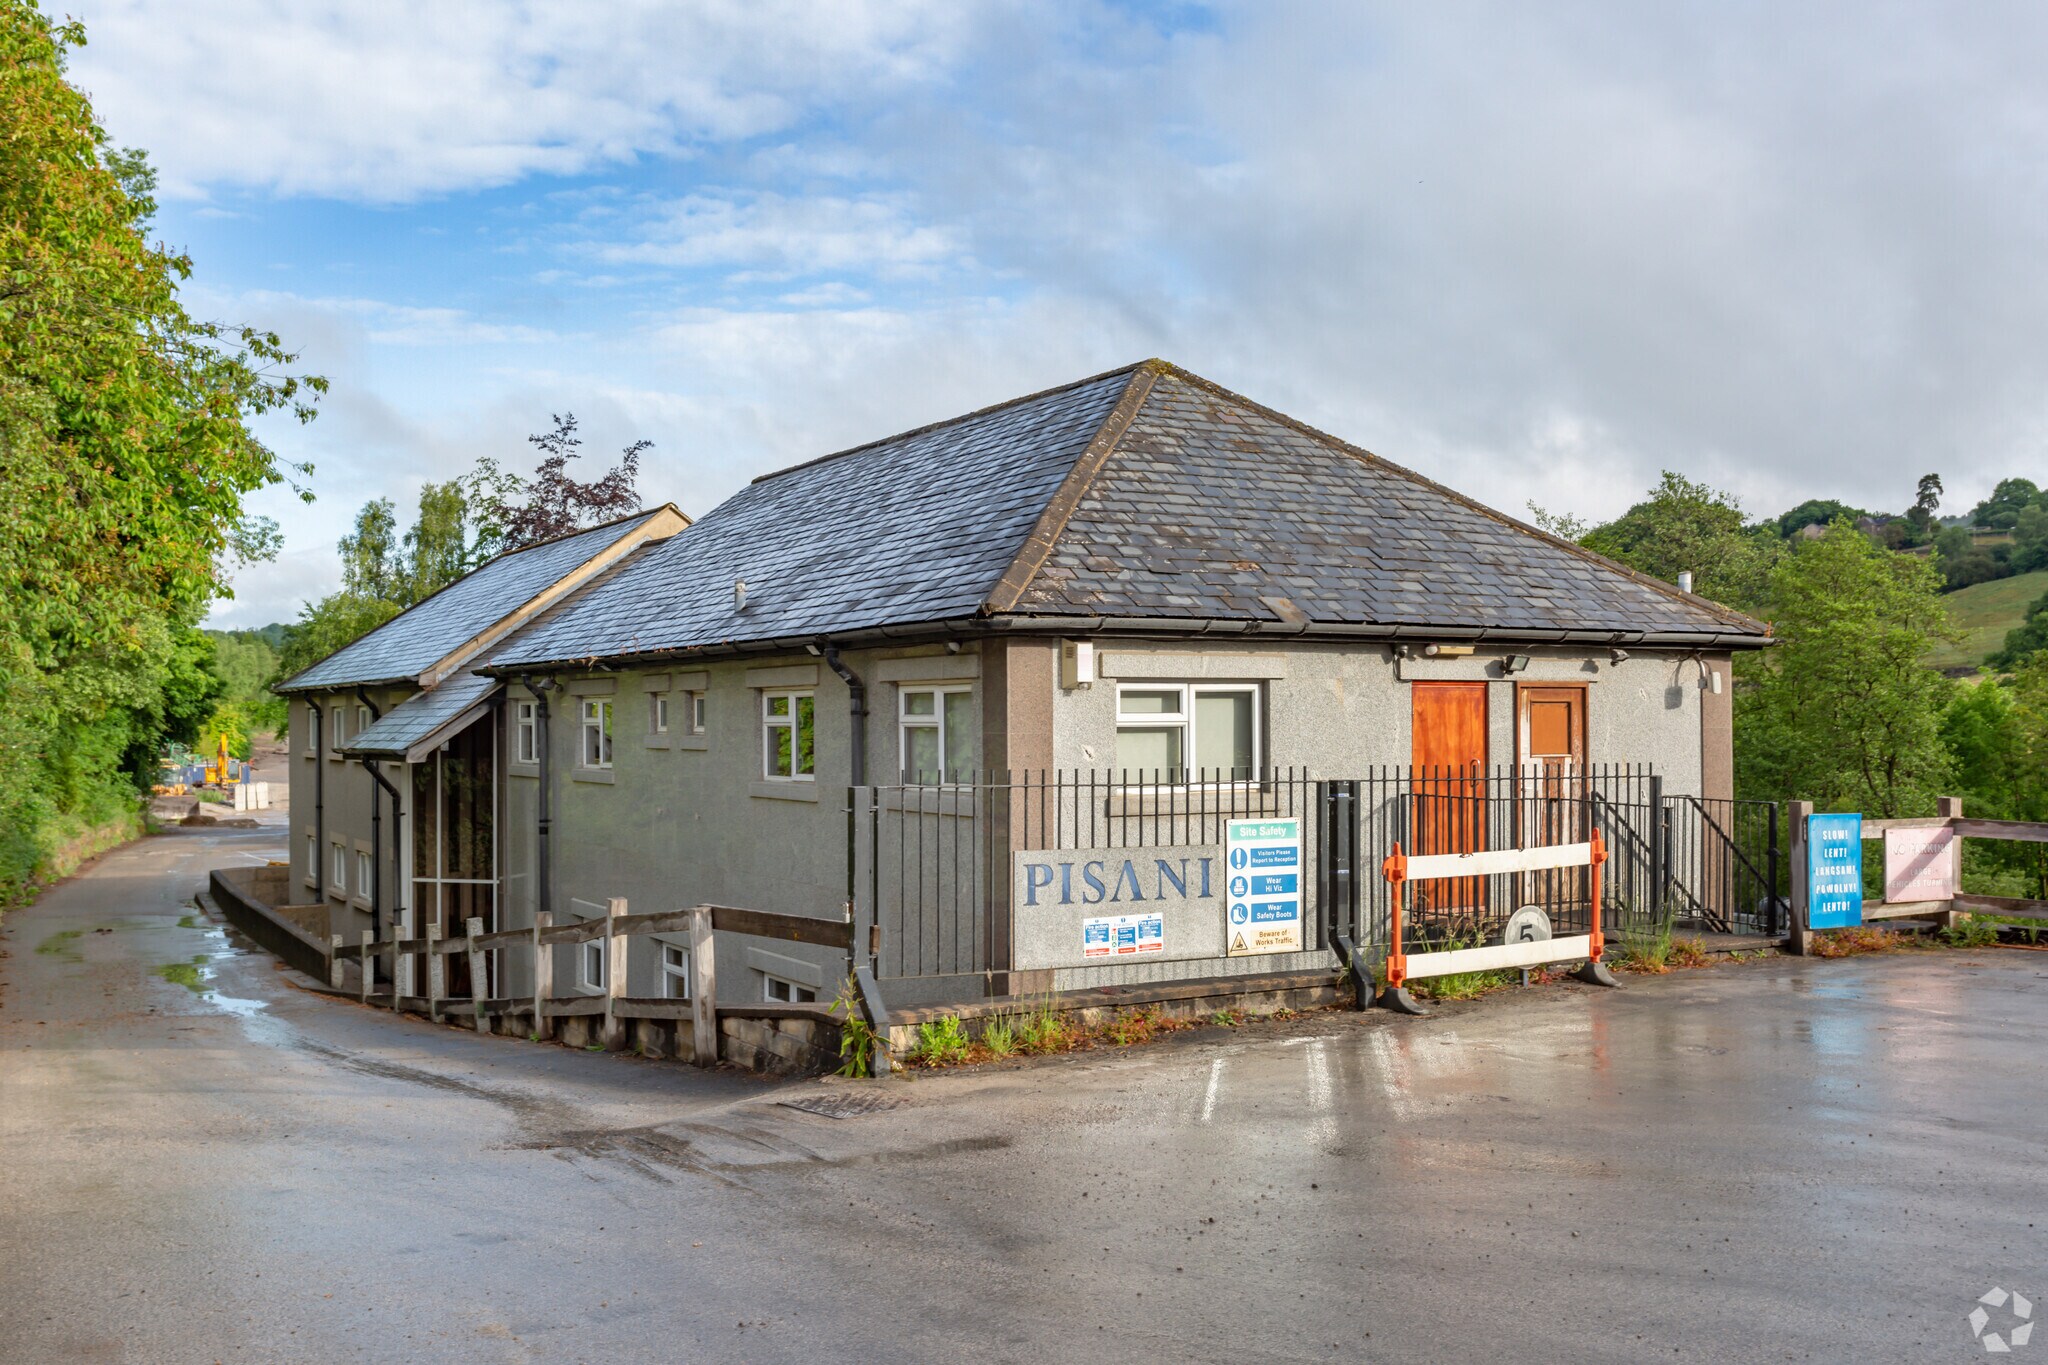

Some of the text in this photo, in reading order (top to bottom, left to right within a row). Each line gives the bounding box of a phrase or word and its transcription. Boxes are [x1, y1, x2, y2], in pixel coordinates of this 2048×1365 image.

[1240, 826, 1286, 837] Site Safety
[1822, 830, 1848, 840] SLOW!
[1824, 848, 1847, 858] LENT!
[1891, 843, 1906, 855] NO
[1815, 865, 1856, 876] LANGSAM!
[1023, 857, 1213, 906] PISANI
[1823, 901, 1851, 912] LENTO!
[1256, 912, 1274, 920] Safety
[1256, 938, 1274, 946] Works
